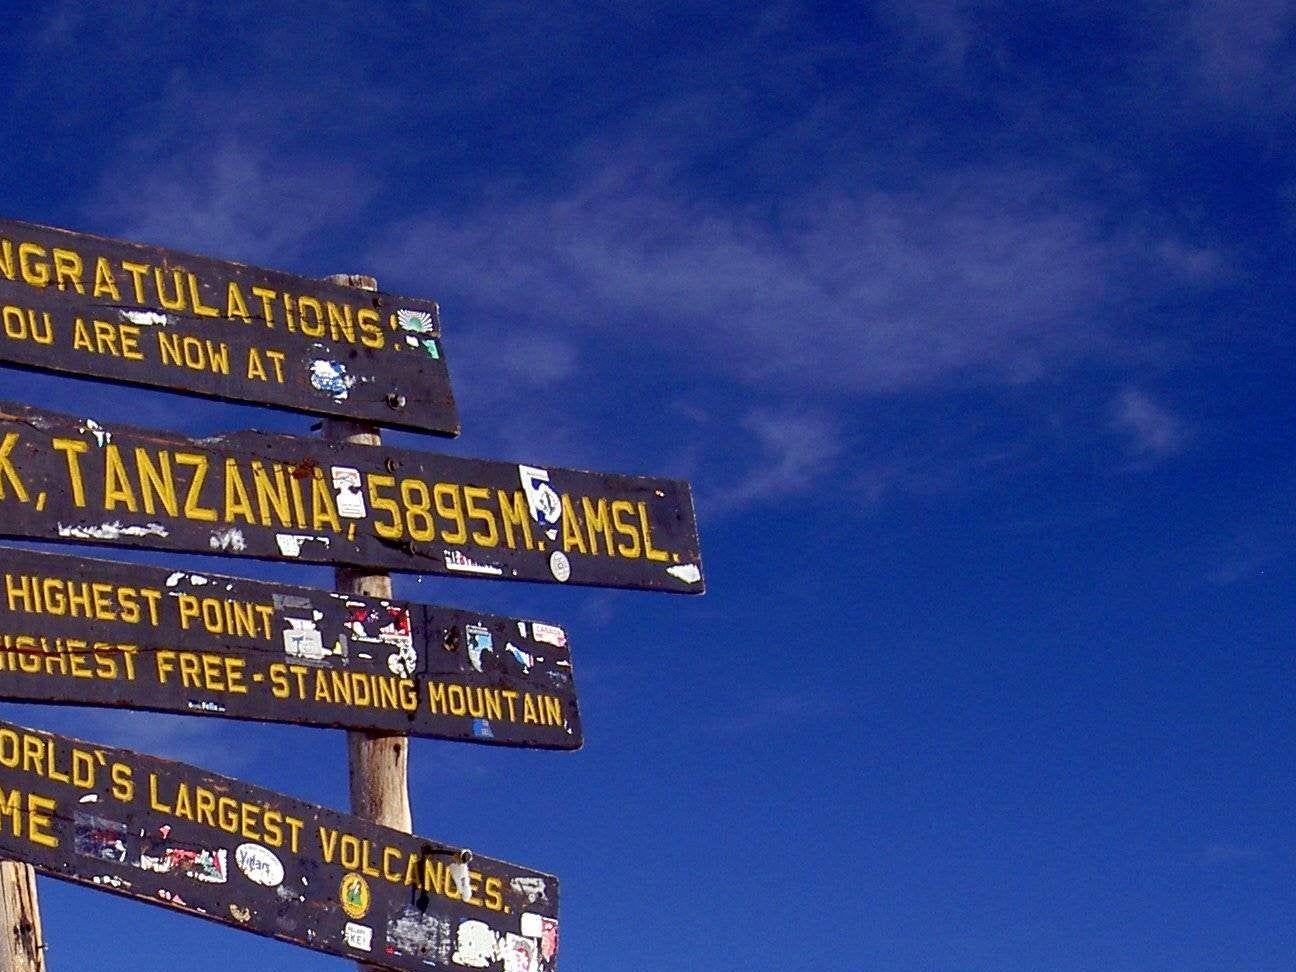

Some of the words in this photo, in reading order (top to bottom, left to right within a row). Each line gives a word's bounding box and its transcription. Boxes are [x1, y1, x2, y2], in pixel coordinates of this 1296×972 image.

[73, 318, 145, 360] ARE
[158, 331, 230, 375] NOW
[248, 347, 285, 383] AT
[52, 437, 356, 541] TANZANIA,
[561, 493, 680, 562] AMSL.
[5, 574, 162, 626] HIGHEST
[177, 594, 274, 640] POINT
[427, 681, 565, 726] MOUNTAIN
[149, 773, 304, 853] LARGEST
